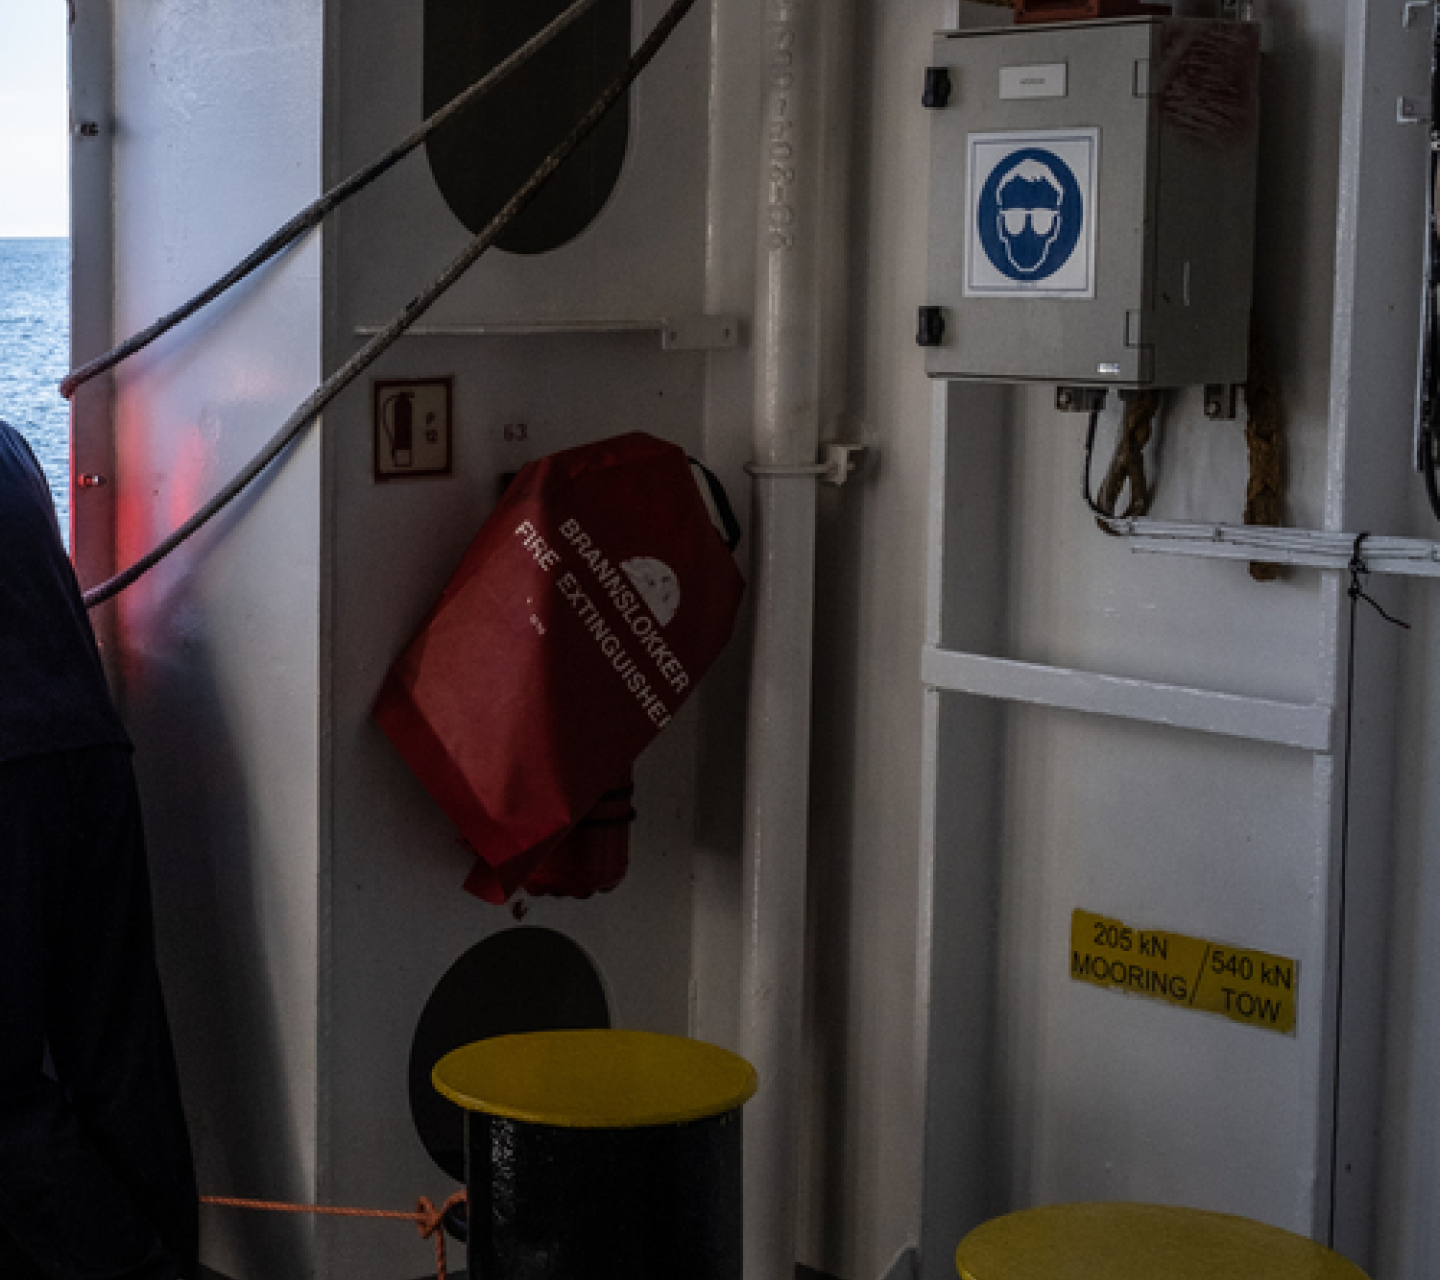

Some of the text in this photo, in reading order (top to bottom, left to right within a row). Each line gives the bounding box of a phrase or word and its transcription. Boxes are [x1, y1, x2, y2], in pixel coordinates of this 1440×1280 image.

[514, 518, 671, 728] FIRE EXTINGUISHE
[560, 518, 689, 693] BRANNSLOKKER
[1071, 950, 1282, 1024] MOORING TOW
[1093, 921, 1133, 952] 205
[1138, 933, 1168, 961] kN
[1211, 950, 1254, 981] 540
[1260, 961, 1292, 990] kN
